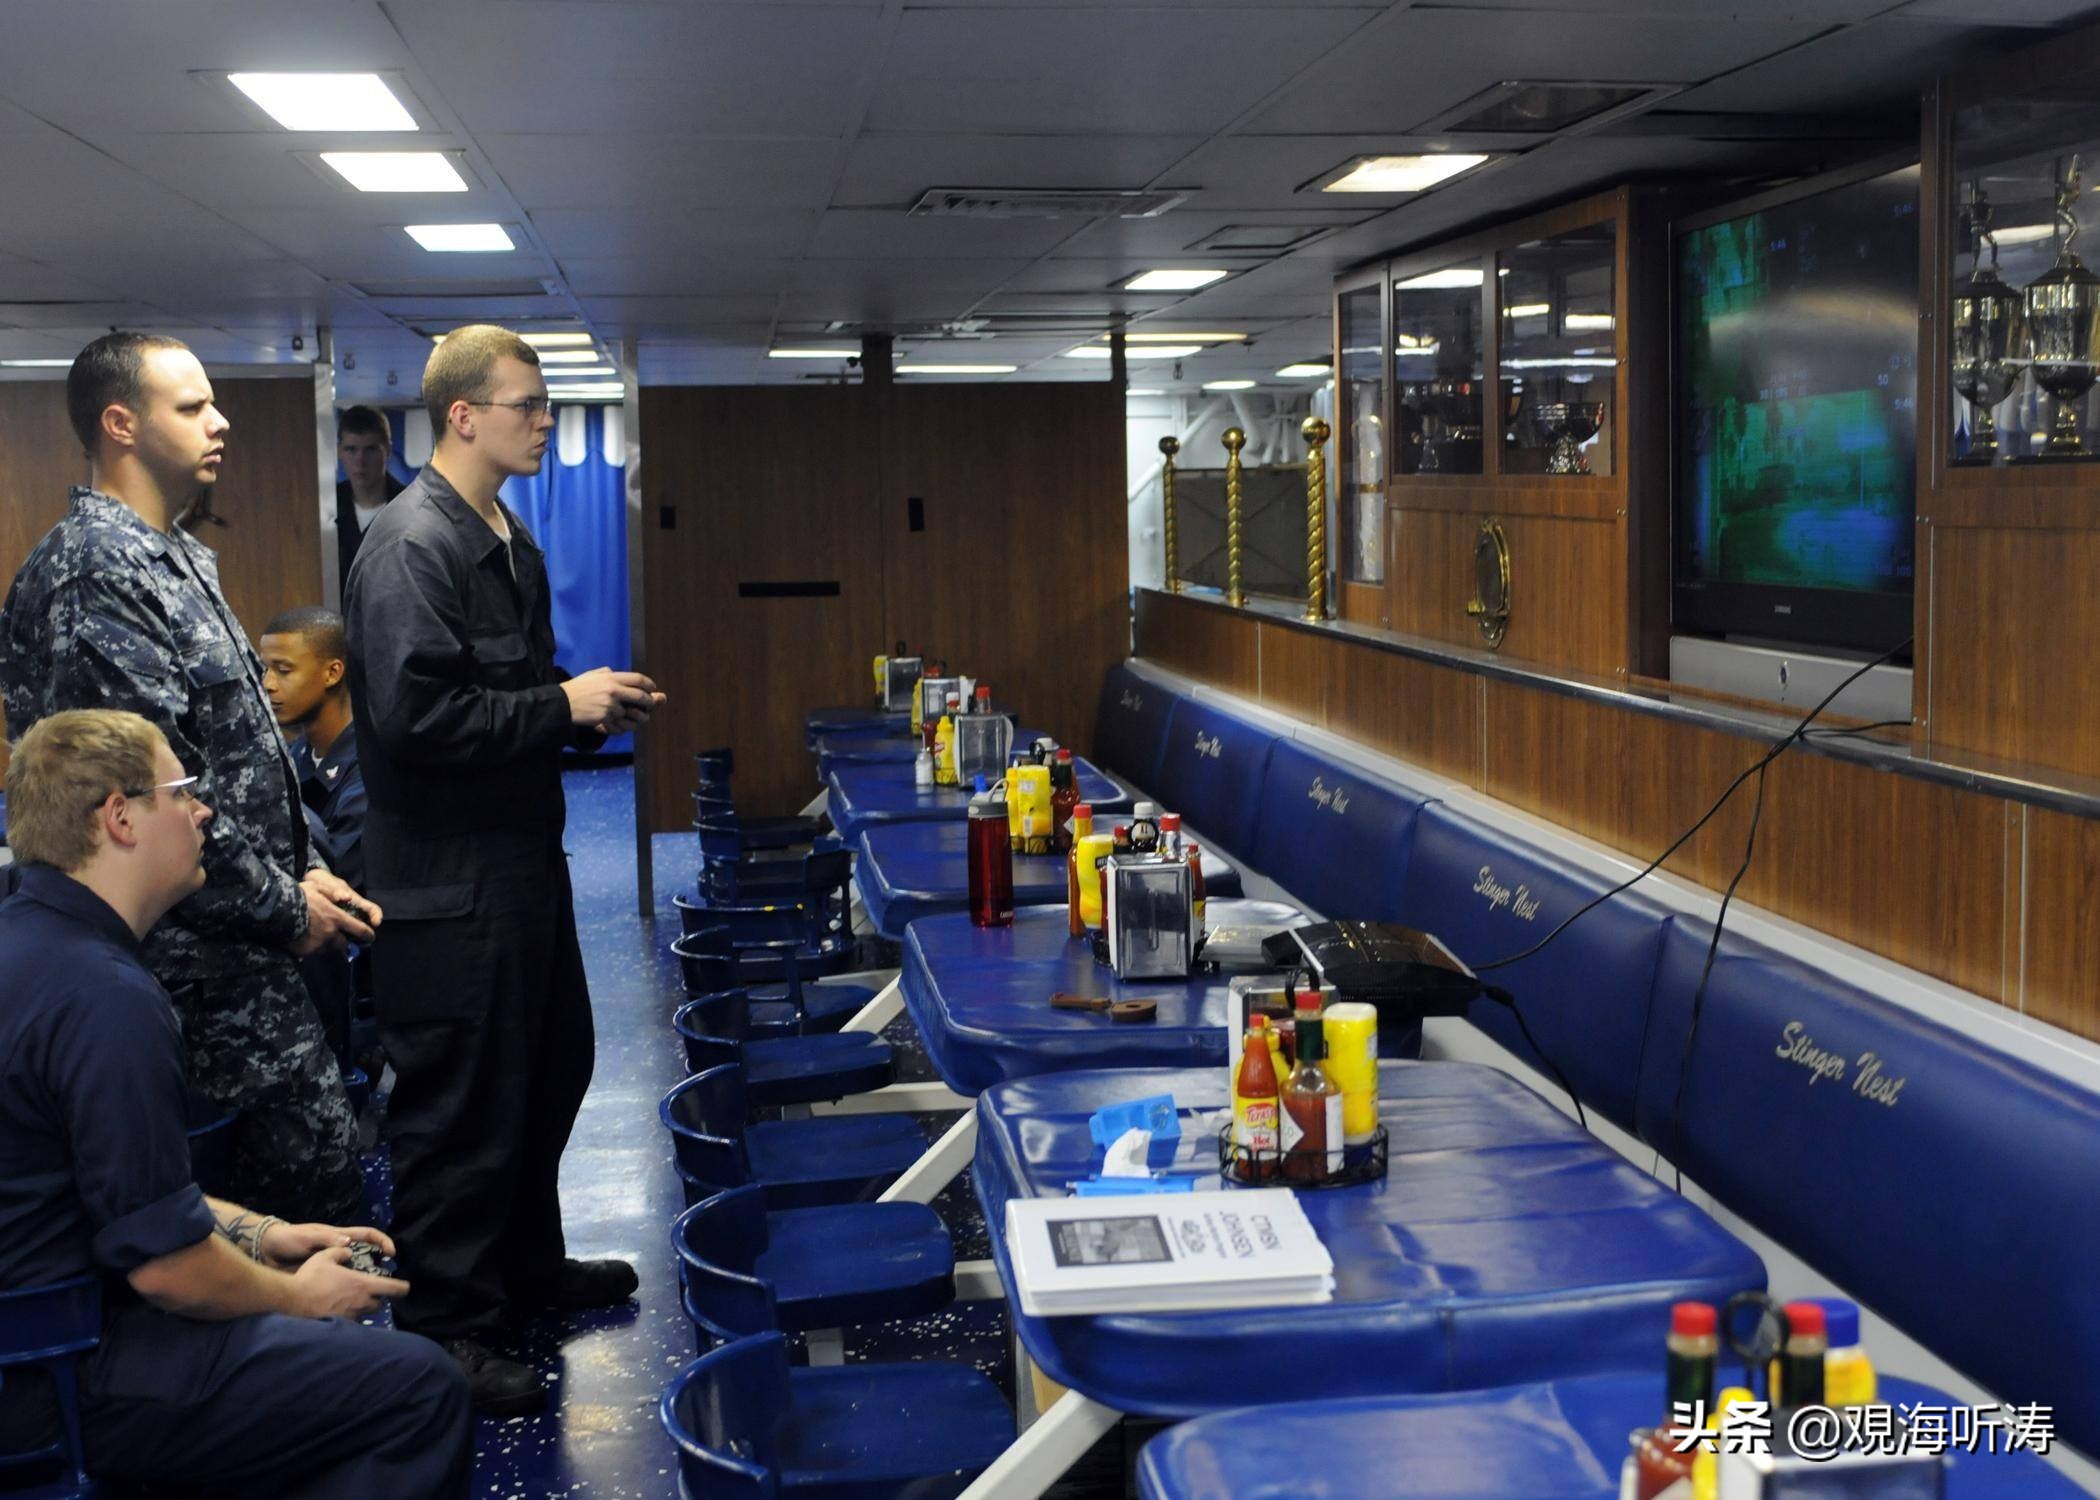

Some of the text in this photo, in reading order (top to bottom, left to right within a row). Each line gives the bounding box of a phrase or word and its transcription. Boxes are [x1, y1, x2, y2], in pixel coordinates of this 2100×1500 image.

[1473, 866, 1540, 920] Stinger Nest
[1776, 1021, 1905, 1106] Stinger Nest
